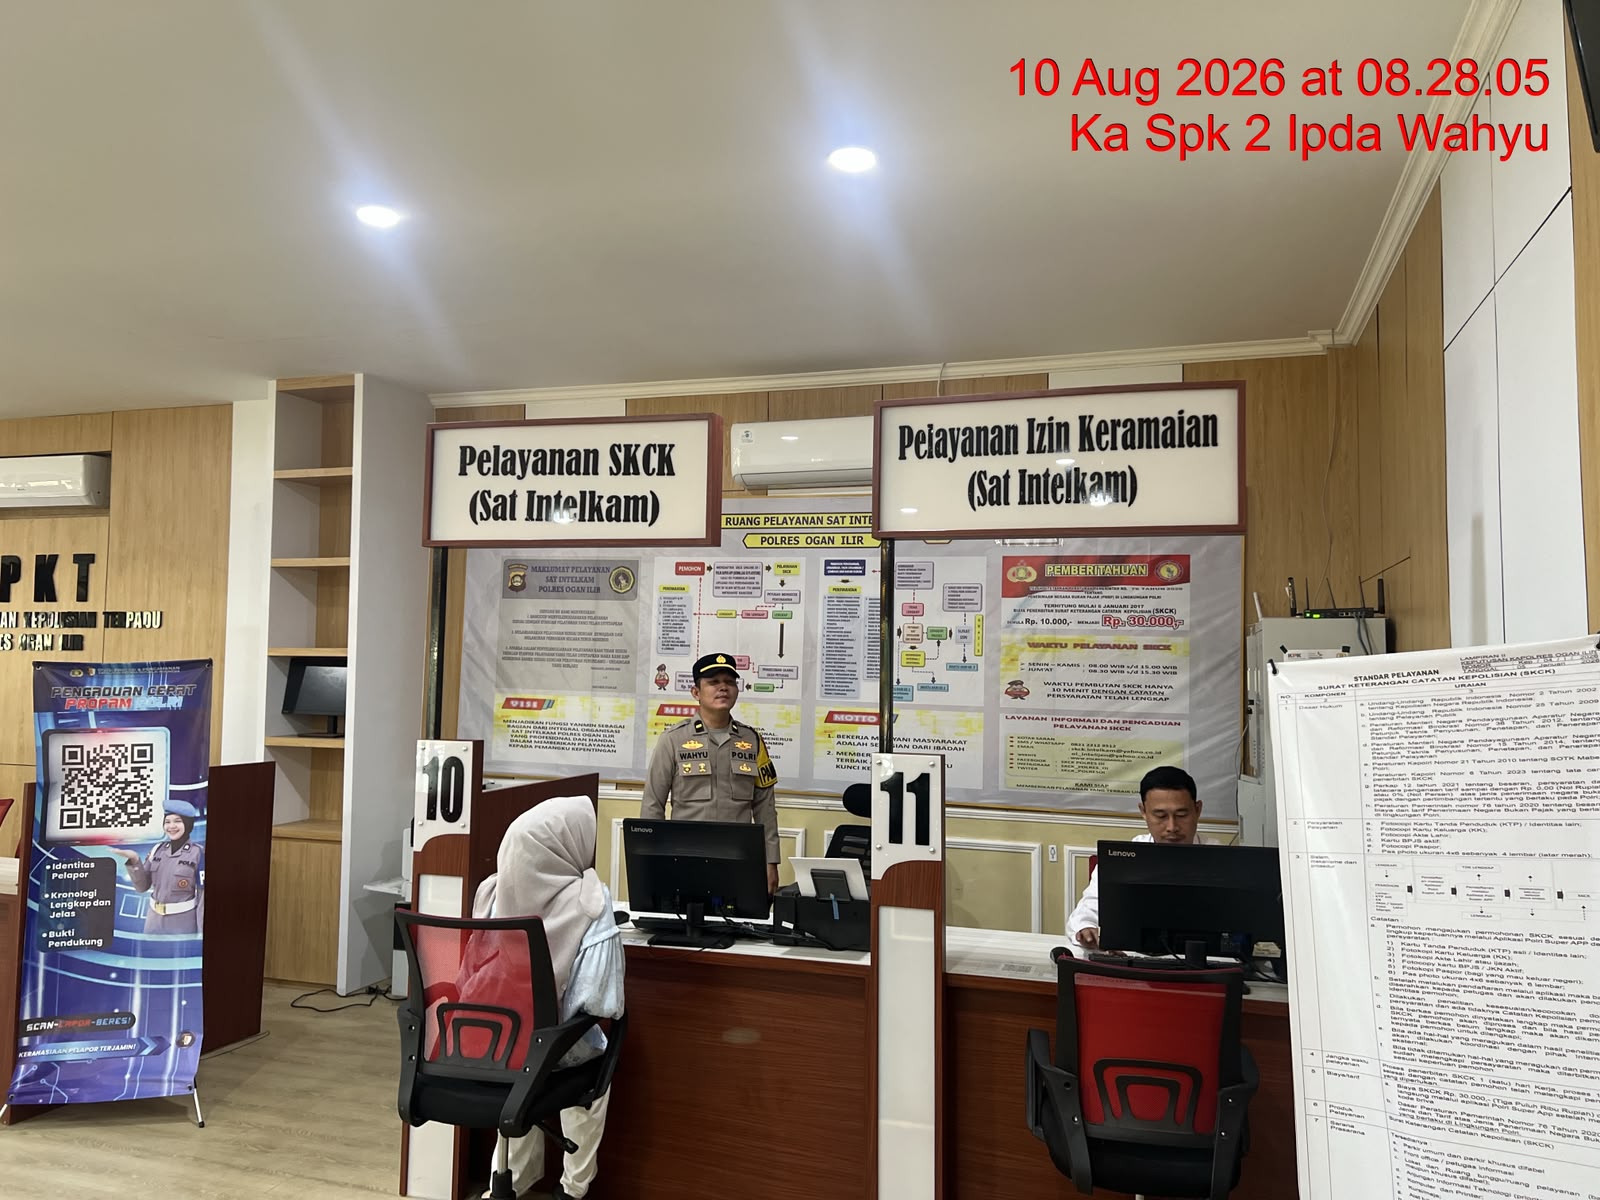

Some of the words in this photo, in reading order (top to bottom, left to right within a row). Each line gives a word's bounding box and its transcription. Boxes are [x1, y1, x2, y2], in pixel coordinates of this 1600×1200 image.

[898, 421, 1019, 463] Pelayanan
[1026, 416, 1071, 455] Izin
[1078, 409, 1219, 452] Keramaian
[458, 445, 600, 480] Pelayanan
[609, 443, 676, 477] SKCK
[967, 469, 1011, 512] (Sat
[1017, 465, 1138, 507] Intelkam)
[469, 489, 518, 525] (Sat
[525, 490, 660, 527] Intelkam)
[725, 517, 761, 527] RUANG
[763, 516, 824, 526] PELAYANAN
[826, 516, 847, 526] SAT
[760, 536, 799, 546] POLRES
[805, 536, 835, 546] OGAN
[841, 535, 865, 545] ILIR
[531, 565, 570, 573] MAKLUMAT
[571, 566, 611, 574] PELAYANAN
[1046, 564, 1148, 576] PEMBERITAHUAN
[558, 576, 595, 584] INTELKAM
[1025, 618, 1038, 626] Rp.
[1041, 618, 1072, 627] 10.000,-
[1102, 615, 1126, 629] Rp.
[1127, 616, 1184, 630] 30.000,-
[1348, 680, 1410, 689] KETERANGAN
[1411, 675, 1460, 685] CATATAN
[1458, 671, 1518, 681] KEPOLISIAN
[1520, 669, 1556, 677] (SKCK)
[1354, 672, 1390, 682] STANDAR
[1391, 669, 1440, 679] PELAYANAN
[51, 685, 143, 699] PENGADUAN
[65, 698, 133, 710] PROPAM
[913, 737, 968, 745] MASYARAKAT
[680, 751, 708, 760] WAHYU
[732, 751, 756, 761] POLRI
[422, 756, 465, 823] 10
[880, 771, 930, 846] 11
[1108, 849, 1137, 858] Lenovo
[52, 861, 95, 870] Identitas
[52, 871, 88, 880] Pelapor
[51, 889, 97, 900] Kronologi
[50, 900, 92, 909] Lengkap
[93, 898, 111, 907] dan
[50, 910, 76, 919] Jelas
[49, 929, 75, 938] Bukti
[48, 938, 103, 948] Pendukung
[68, 1046, 98, 1055] PELAPOR
[100, 1043, 137, 1053] TERJAMIN!
[1418, 1087, 1441, 1095] SKCK
[1515, 1101, 1538, 1109] Puluh
[1561, 1107, 1595, 1118] Rupiah)
